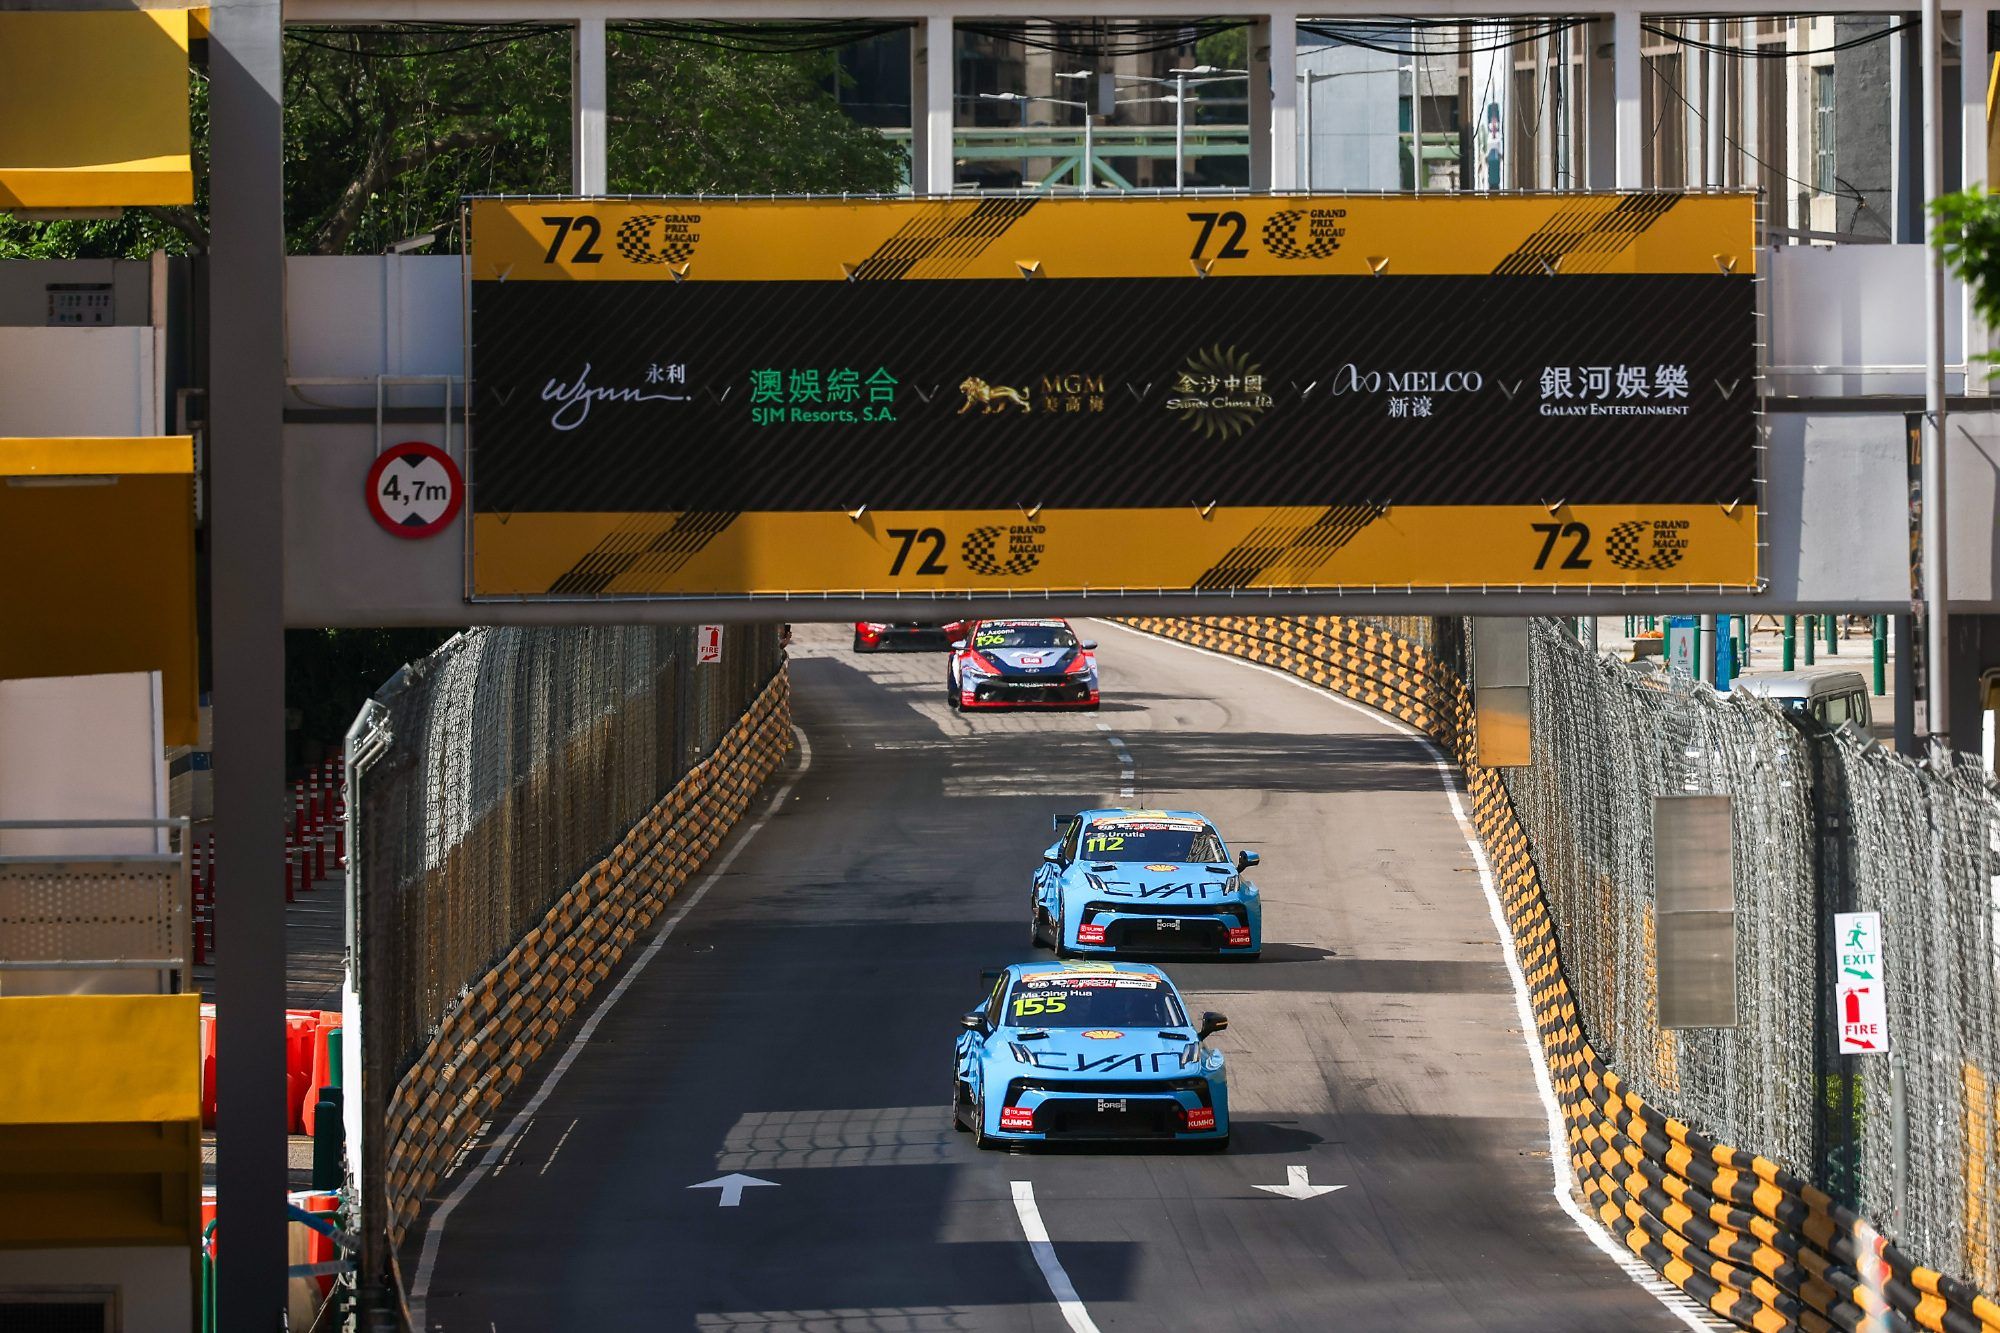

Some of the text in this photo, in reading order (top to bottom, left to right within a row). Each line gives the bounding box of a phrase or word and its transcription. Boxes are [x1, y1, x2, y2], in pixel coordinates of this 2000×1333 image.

[664, 214, 701, 224] GRAND
[1310, 209, 1347, 218] GRAND
[664, 224, 689, 233] PRIX
[1310, 219, 1334, 228] PRIX
[664, 233, 700, 243] MACAU
[1186, 211, 1250, 259] 72
[1309, 228, 1346, 237] MACAU
[541, 215, 604, 264] 72
[645, 363, 686, 384] 永利
[750, 366, 899, 403] 澳娛綜合
[1041, 374, 1105, 394] MGM
[1178, 374, 1262, 394] 金沙中國
[1386, 371, 1483, 392] MELCO
[1540, 363, 1689, 400] 銀河娛樂
[1388, 395, 1433, 418] 新濠
[752, 406, 897, 426] SJM Resorts, S.A.
[1009, 525, 1046, 534] GRAND
[1653, 520, 1690, 529] GRAND
[1009, 535, 1034, 544] PRIX
[1653, 530, 1677, 539] PRIX
[1008, 544, 1045, 553] MACAU
[1531, 521, 1593, 570] 72
[1652, 539, 1689, 548] MACAU
[886, 527, 949, 576] 72
[975, 635, 1005, 647] 196
[1086, 837, 1125, 852] 112
[1843, 954, 1876, 965] EXIT
[1040, 990, 1068, 998] Qing
[1013, 996, 1067, 1017] 155
[1845, 1023, 1878, 1035] FIRE
[1188, 1119, 1214, 1127] KUMHO
